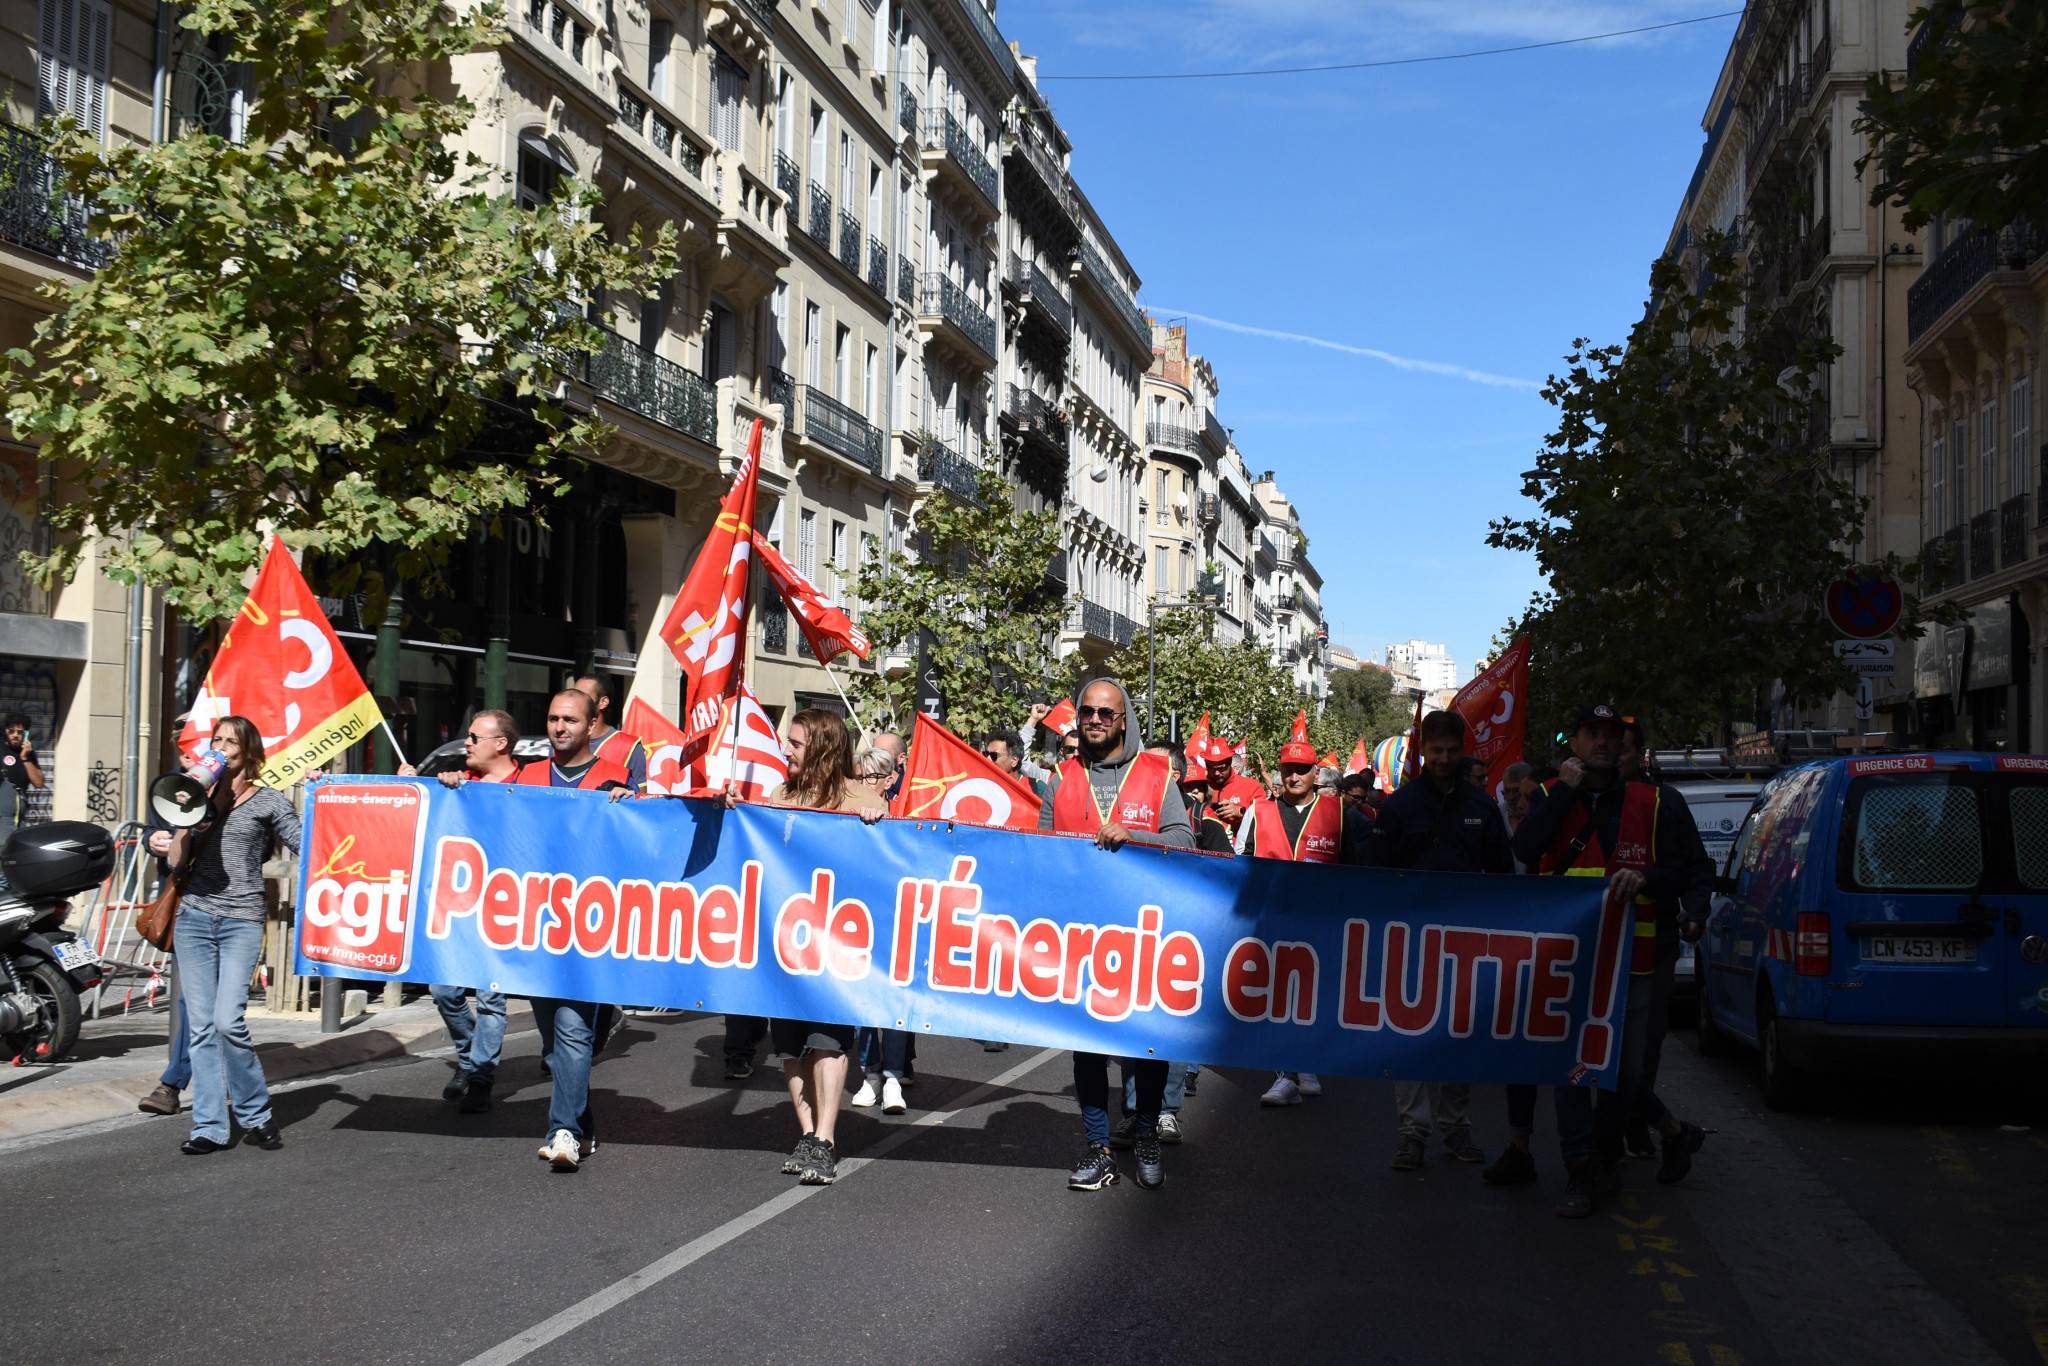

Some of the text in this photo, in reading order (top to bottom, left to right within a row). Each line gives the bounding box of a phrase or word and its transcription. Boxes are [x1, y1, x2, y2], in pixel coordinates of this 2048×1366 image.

[1856, 664, 1894, 672] LIVRAISON
[1855, 758, 1928, 771] URGENCE GAZ
[317, 789, 418, 807] mines-énergie
[304, 869, 410, 948] cgt
[426, 835, 764, 968] Personnel
[773, 867, 873, 981] de
[890, 855, 1205, 1023] l'Énergie
[1222, 936, 1318, 1026] en
[1338, 918, 1580, 1042] LUTTE
